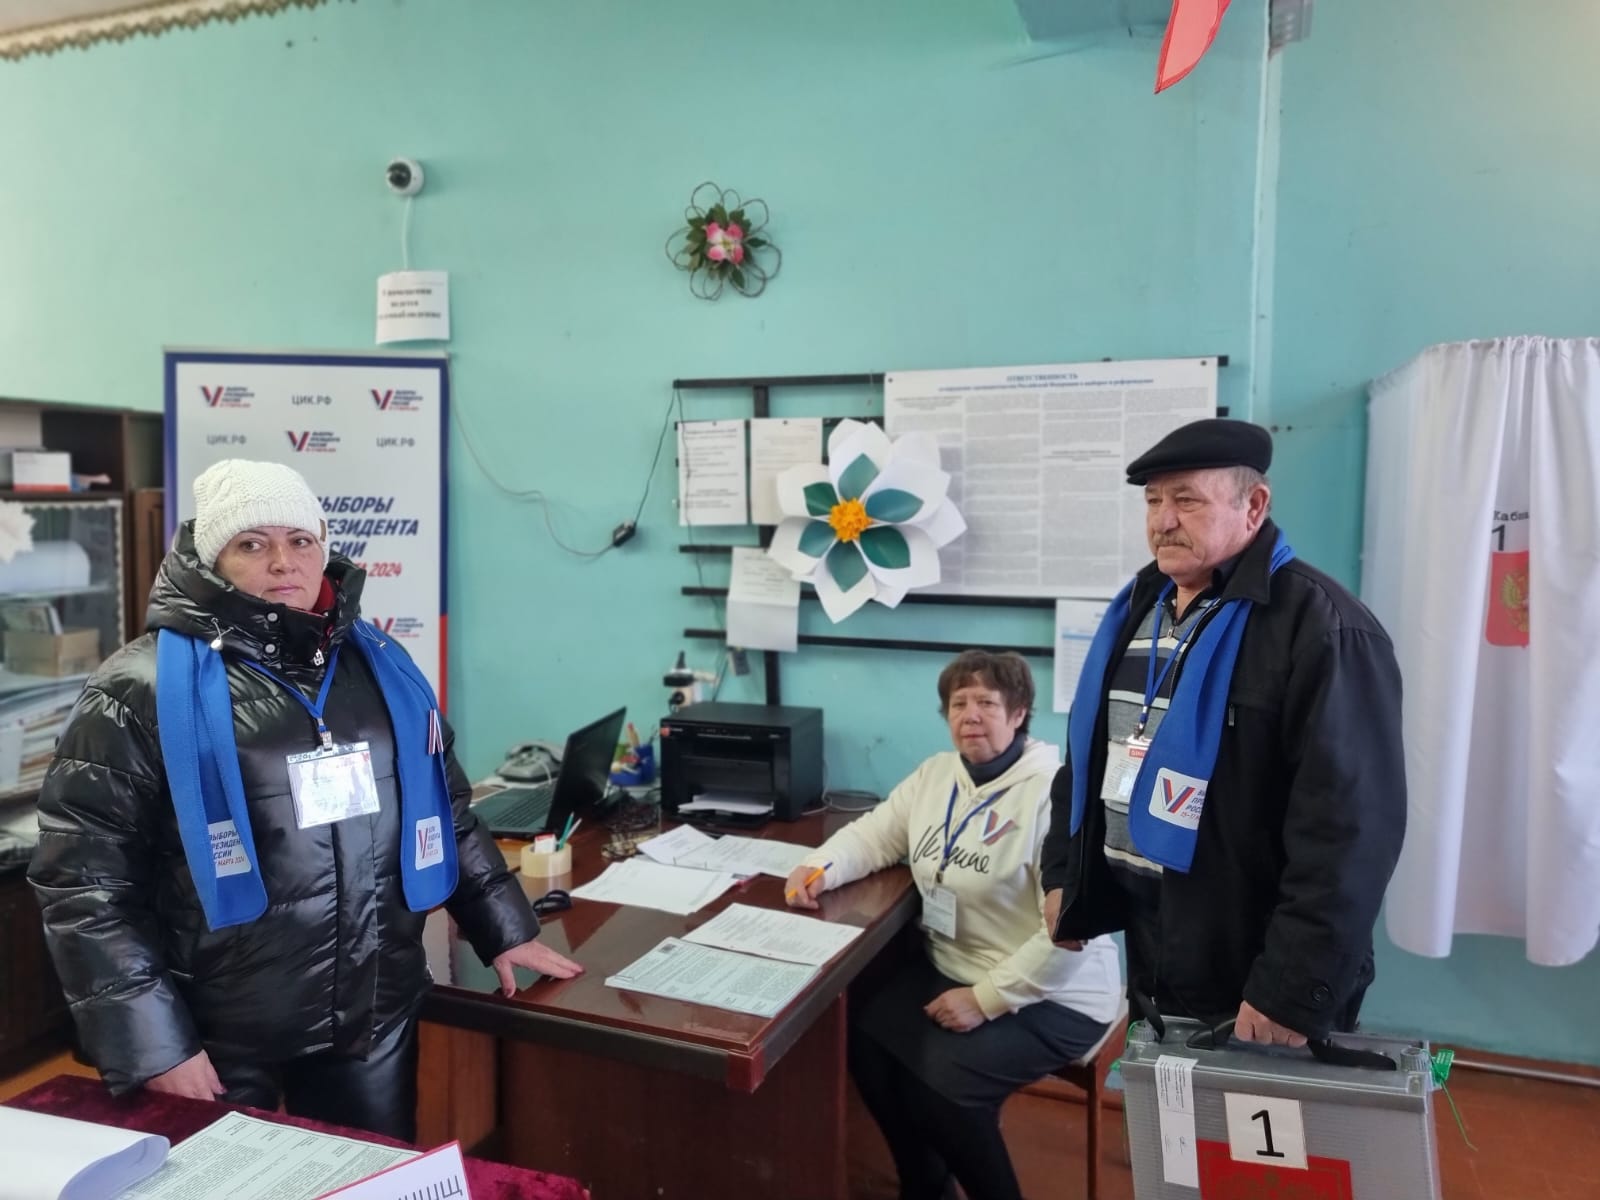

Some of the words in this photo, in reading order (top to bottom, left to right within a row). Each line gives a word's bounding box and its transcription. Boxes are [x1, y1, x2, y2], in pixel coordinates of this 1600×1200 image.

[291, 395, 333, 406] ЦИК.РФ
[206, 433, 247, 445] ЦИК.РФ
[376, 437, 416, 448] ЦИК.РФ
[318, 496, 394, 513] ЫБОРЫ
[1491, 524, 1505, 551] 1
[1251, 1109, 1285, 1158] 1
